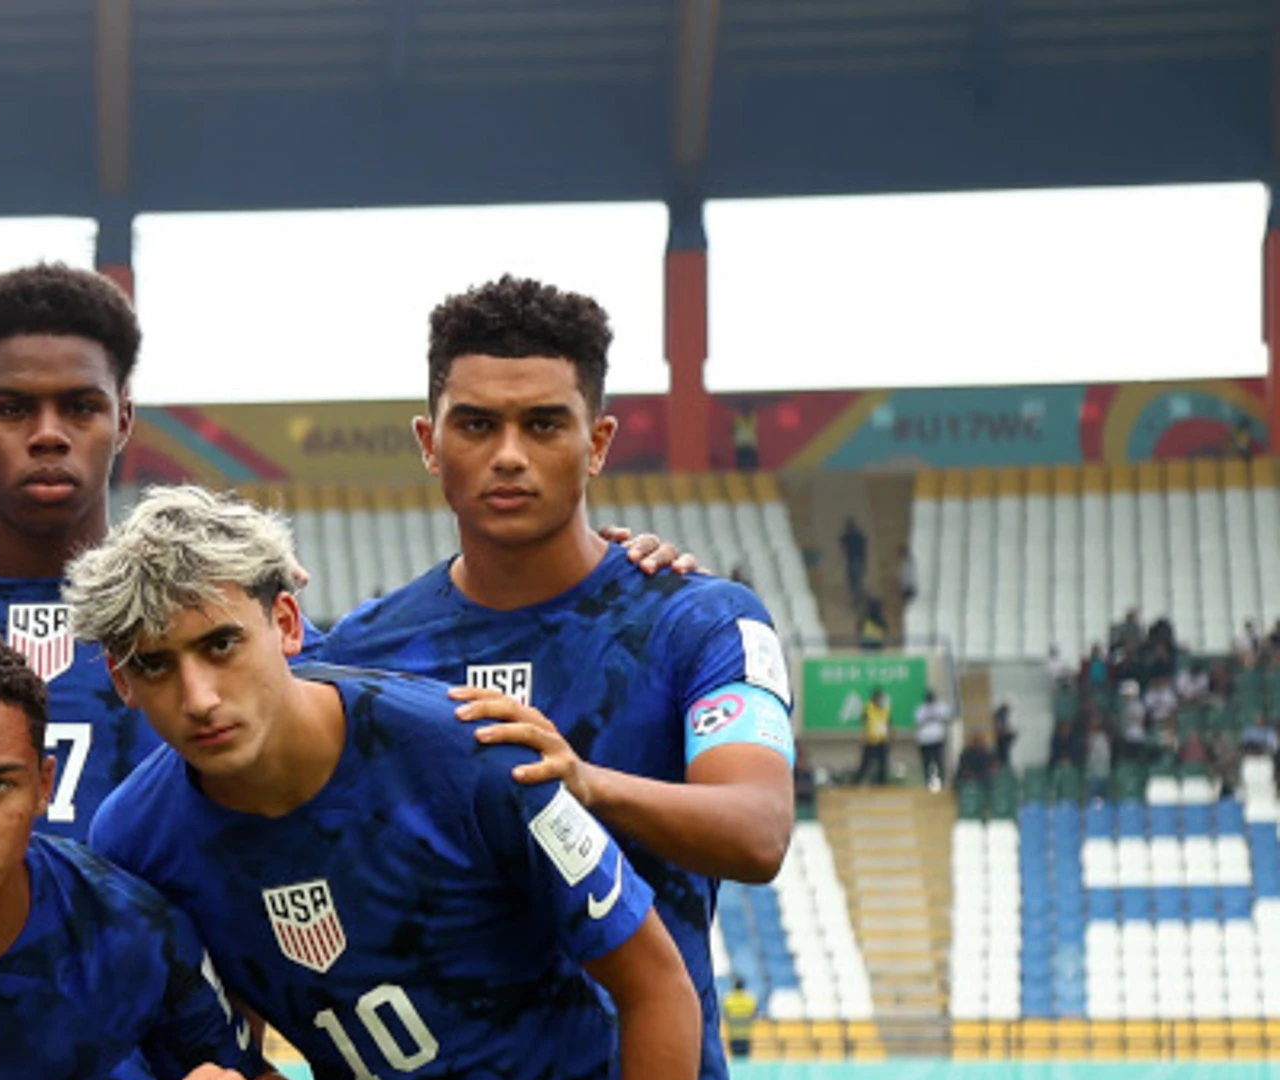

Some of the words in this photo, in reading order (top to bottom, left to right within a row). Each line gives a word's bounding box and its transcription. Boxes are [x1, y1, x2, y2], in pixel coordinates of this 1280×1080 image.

[12, 607, 69, 638] USA
[472, 668, 527, 695] USA
[44, 722, 93, 823] 7
[269, 886, 328, 924] USA
